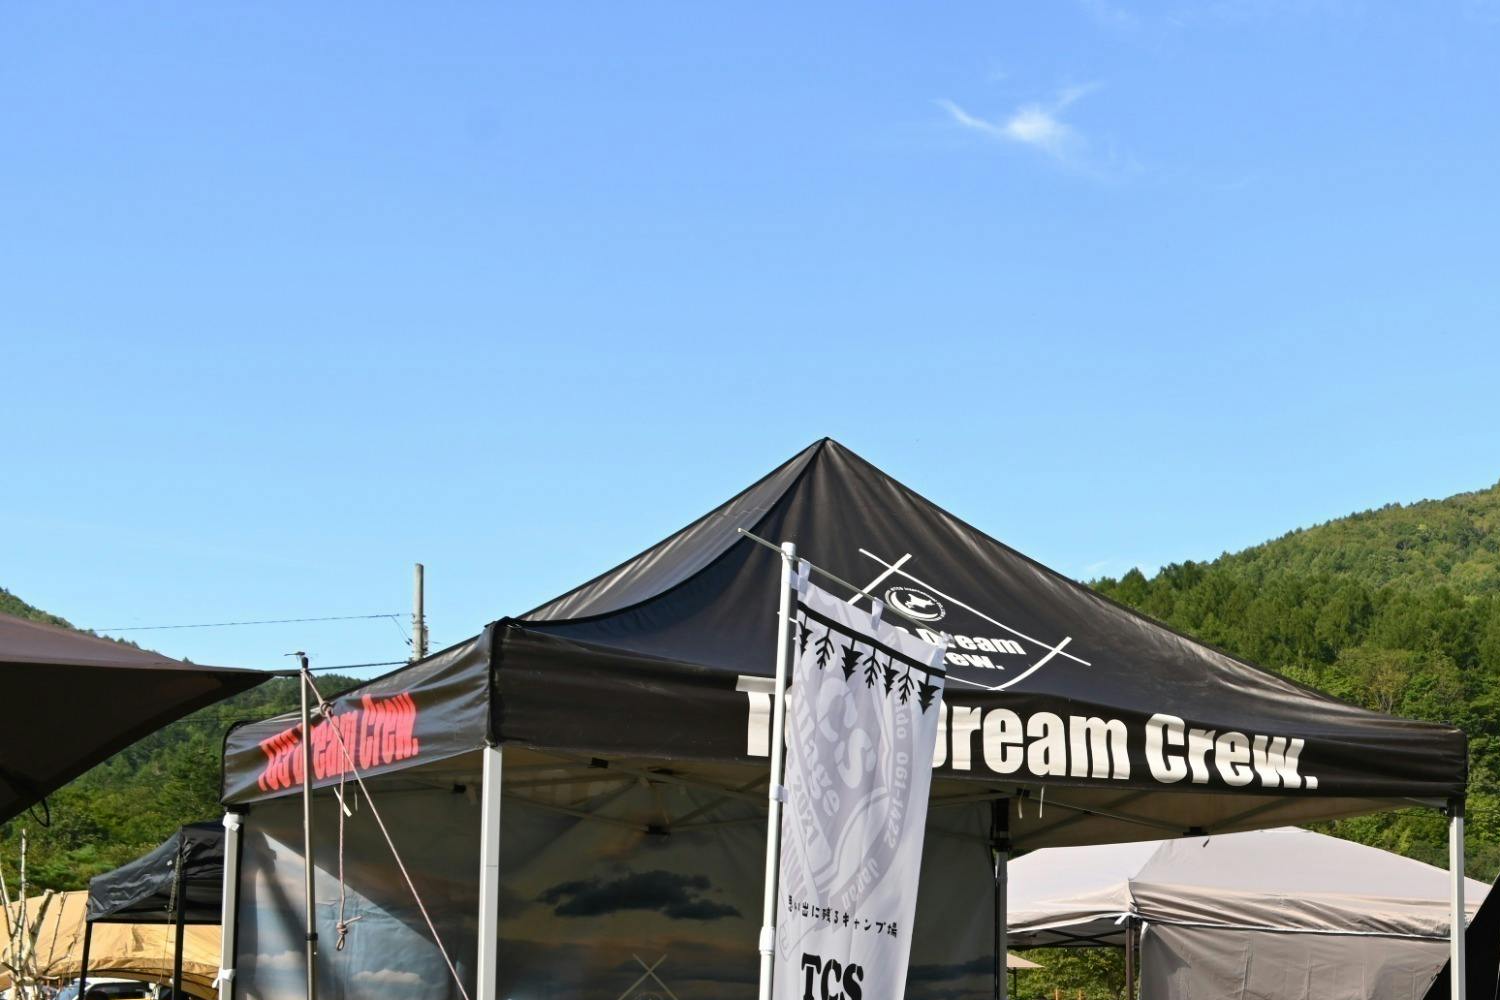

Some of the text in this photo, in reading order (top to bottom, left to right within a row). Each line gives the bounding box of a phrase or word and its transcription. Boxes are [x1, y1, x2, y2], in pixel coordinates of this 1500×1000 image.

[943, 652, 1005, 670] ew.
[359, 692, 419, 770] Crew.
[1145, 713, 1319, 790] Crew.
